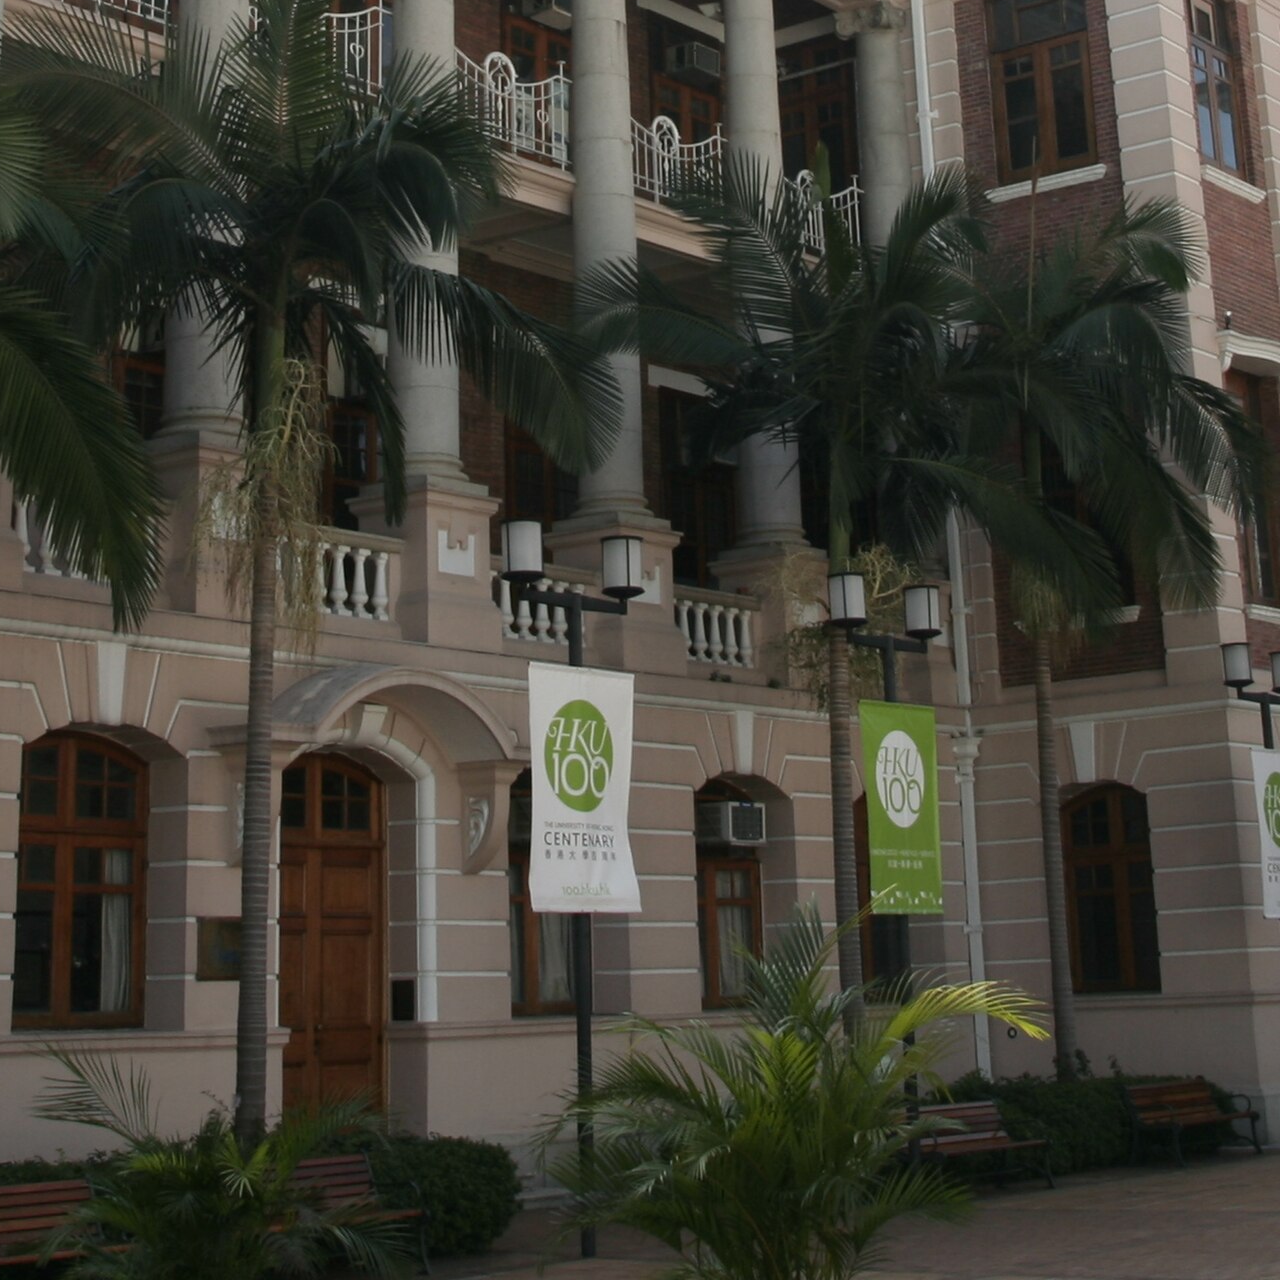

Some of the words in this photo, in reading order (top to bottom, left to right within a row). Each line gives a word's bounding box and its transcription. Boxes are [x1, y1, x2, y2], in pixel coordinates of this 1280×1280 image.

[546, 716, 608, 758] HKU
[552, 752, 610, 799] 100
[878, 745, 920, 778] HKU
[882, 777, 923, 815] 100
[543, 831, 615, 848] CENTENARY
